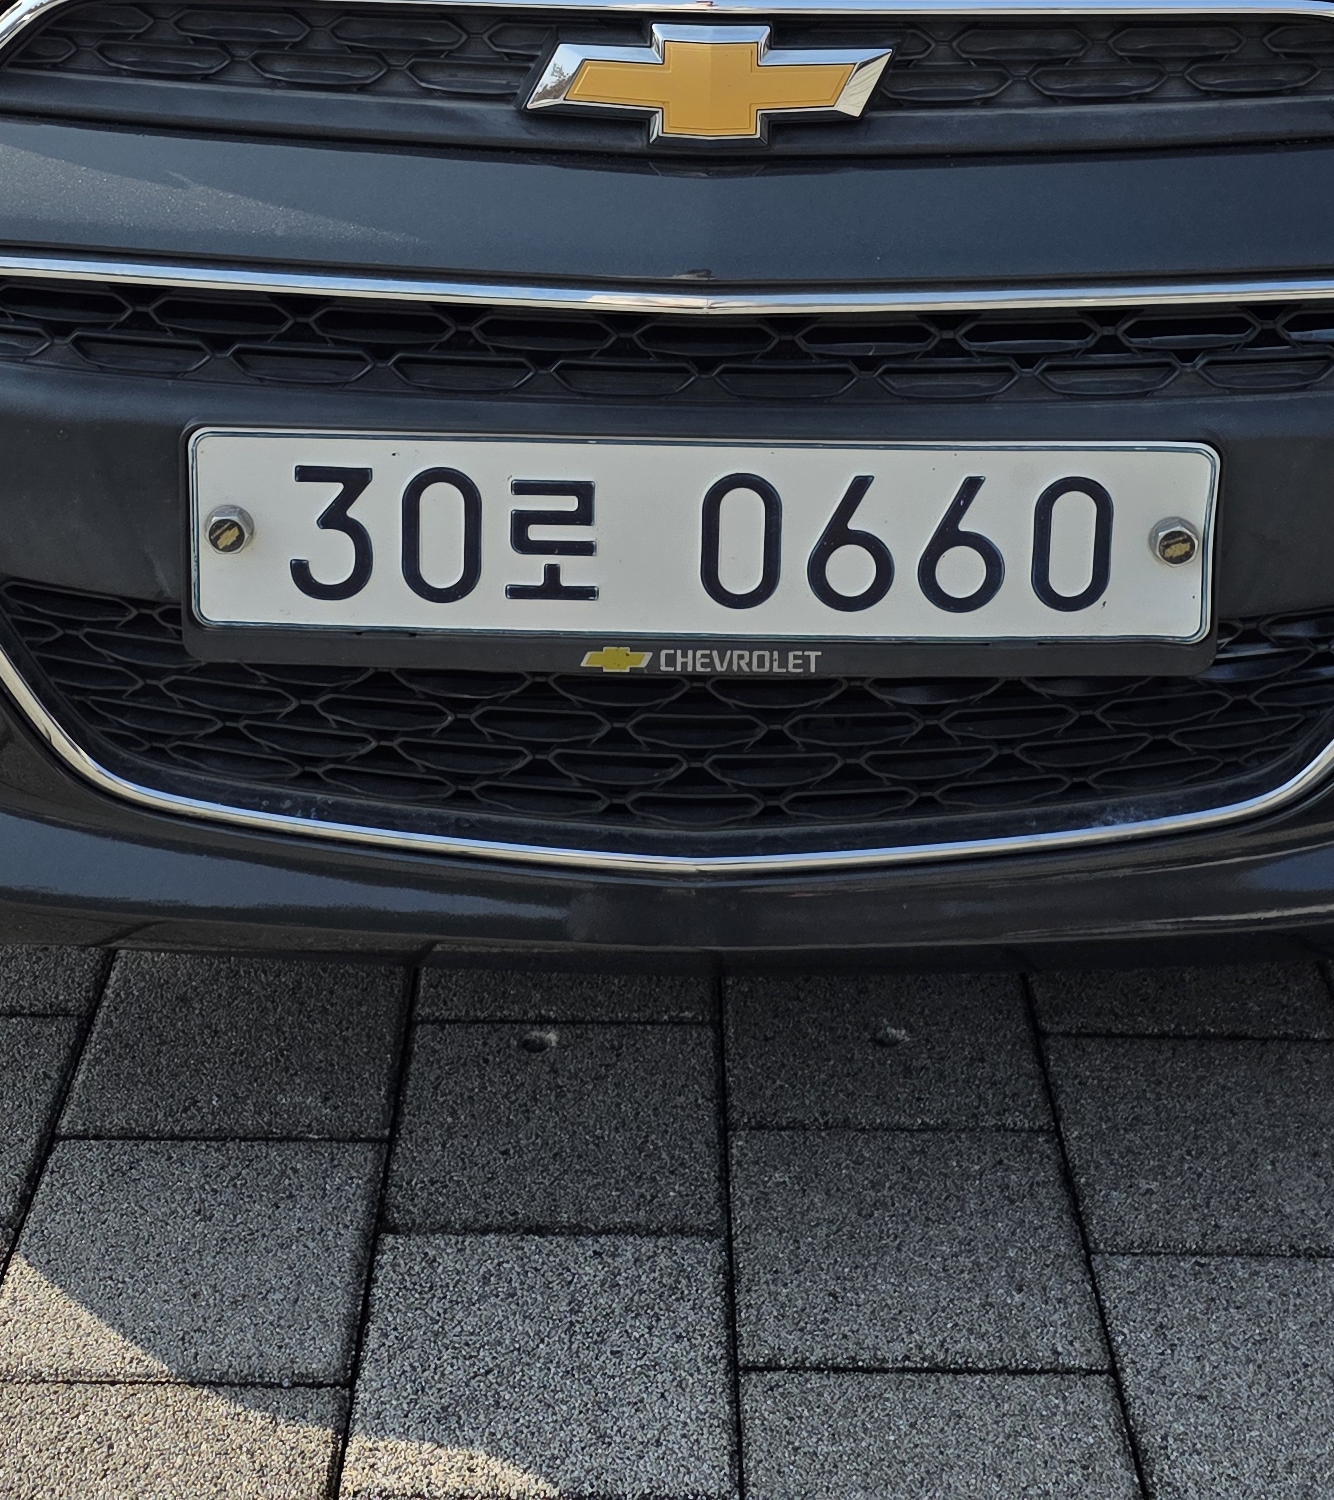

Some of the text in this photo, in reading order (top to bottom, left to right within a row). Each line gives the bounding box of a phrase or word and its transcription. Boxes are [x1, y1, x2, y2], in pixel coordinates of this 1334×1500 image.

[289, 465, 1114, 612] 30로 0660
[660, 649, 822, 673] CHEVROLET
